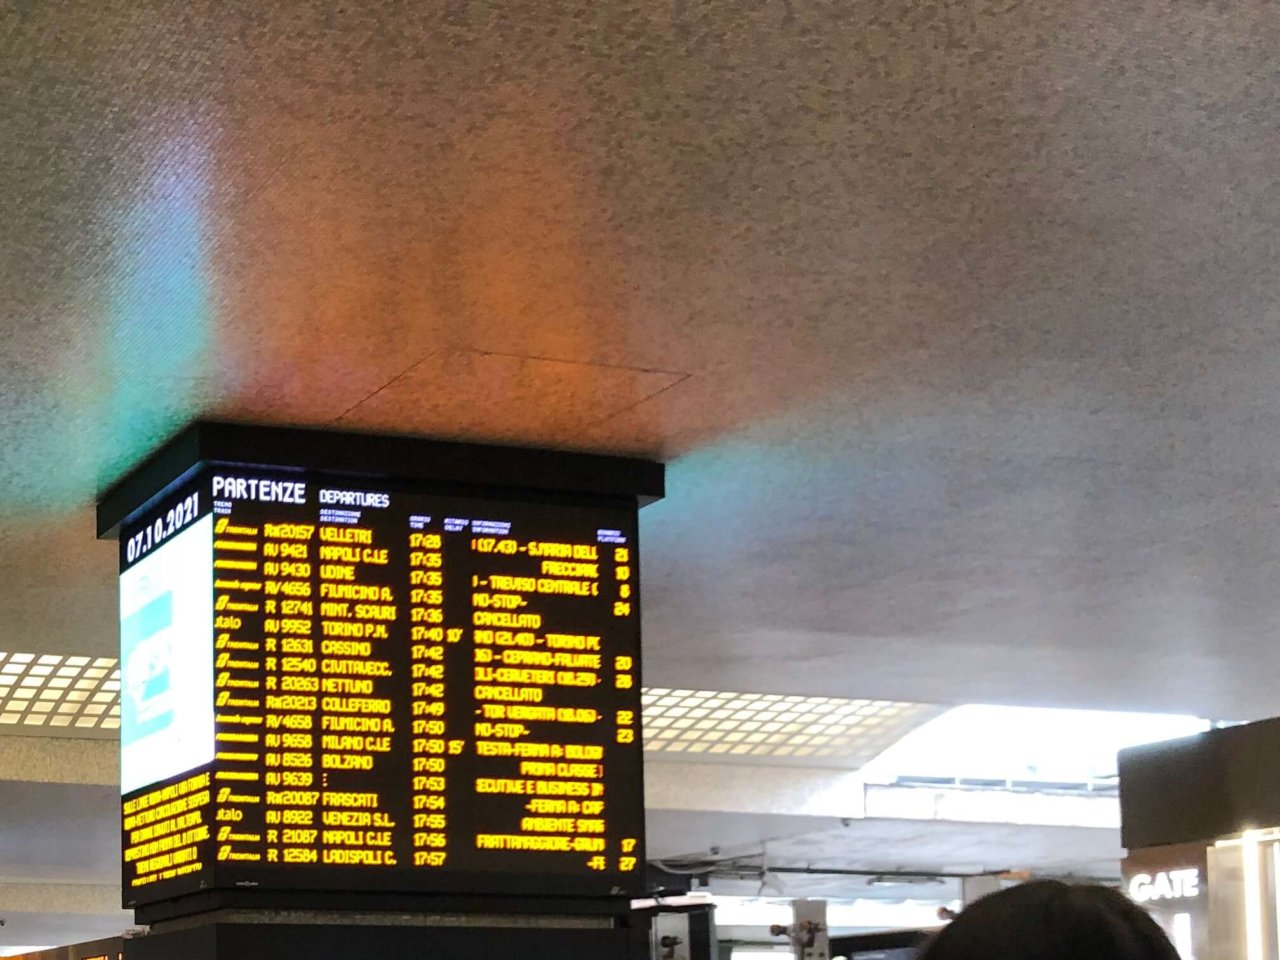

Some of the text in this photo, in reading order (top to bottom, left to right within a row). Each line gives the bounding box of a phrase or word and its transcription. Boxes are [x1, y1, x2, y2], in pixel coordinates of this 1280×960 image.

[212, 476, 306, 503] PARTENZE
[319, 489, 390, 508] DEPARTURES
[127, 491, 199, 563] 07.10.2021
[264, 523, 315, 540] R20157
[320, 526, 372, 544] VELLETRI
[410, 533, 441, 549] 17:28
[264, 543, 279, 557] AV
[280, 542, 307, 559] 9421
[320, 545, 360, 562] NAPOLI
[410, 551, 442, 568] 17:35
[264, 562, 279, 576] AV
[280, 562, 311, 578] 9430
[320, 564, 355, 581] UDINE
[411, 570, 442, 586] 17:35
[489, 575, 537, 592] TREVISO
[537, 578, 590, 596] CENTRALE
[281, 581, 311, 597] 4656
[320, 583, 380, 601] FIUMICINO
[411, 589, 443, 605] 17:35
[265, 600, 276, 614] R
[281, 600, 313, 616] 12741
[355, 604, 396, 621] SCAURI
[411, 607, 443, 623] 17:36
[474, 611, 541, 629] CANCELLATO
[264, 619, 280, 633] AV
[281, 619, 311, 635] 9952
[322, 621, 364, 637] TORINO
[411, 626, 443, 642] 17:40
[265, 638, 277, 652] R
[281, 638, 313, 653] 12631
[321, 640, 371, 657] CASSINO
[412, 645, 444, 660] 17:42
[265, 657, 277, 671] R
[281, 657, 317, 673] 12540
[412, 664, 444, 679] 17:42
[266, 676, 543, 702] R 20263 NETTUNO 17:42 CANCELLATO
[266, 694, 317, 711] R20213
[322, 696, 391, 714] COLLEFERRO
[413, 701, 445, 716] 17:49
[283, 714, 312, 729] 4658
[322, 716, 381, 732] FIUMICINO
[413, 720, 445, 735] 17:50
[265, 734, 281, 748] AV
[282, 733, 312, 748] 9658
[322, 735, 364, 751] MILANO
[413, 738, 445, 754] 17:50
[266, 753, 281, 766] AV
[282, 752, 313, 768] 8526
[322, 754, 373, 770] BOLZANO
[413, 757, 445, 772] 17:50
[556, 763, 598, 778] CLASSE
[266, 772, 281, 786] AV
[282, 771, 313, 786] 9639
[413, 776, 445, 791] 17:53
[267, 790, 320, 806] R20087
[323, 792, 378, 808] FRASCATI
[414, 795, 445, 810] 17:54
[266, 811, 281, 824] AV
[282, 810, 313, 825] 8922
[323, 811, 372, 826] VENEZIA
[414, 814, 446, 829] 17:55
[267, 830, 278, 843] R
[283, 829, 318, 844] 21087
[323, 830, 364, 845] NAPOLI
[414, 832, 446, 847] 17:56
[622, 839, 636, 852] 17
[267, 849, 278, 862] R
[283, 848, 318, 863] 12584
[323, 849, 382, 864] LADISPOLI
[414, 851, 446, 866] 17:57
[1129, 868, 1199, 902] GATE
